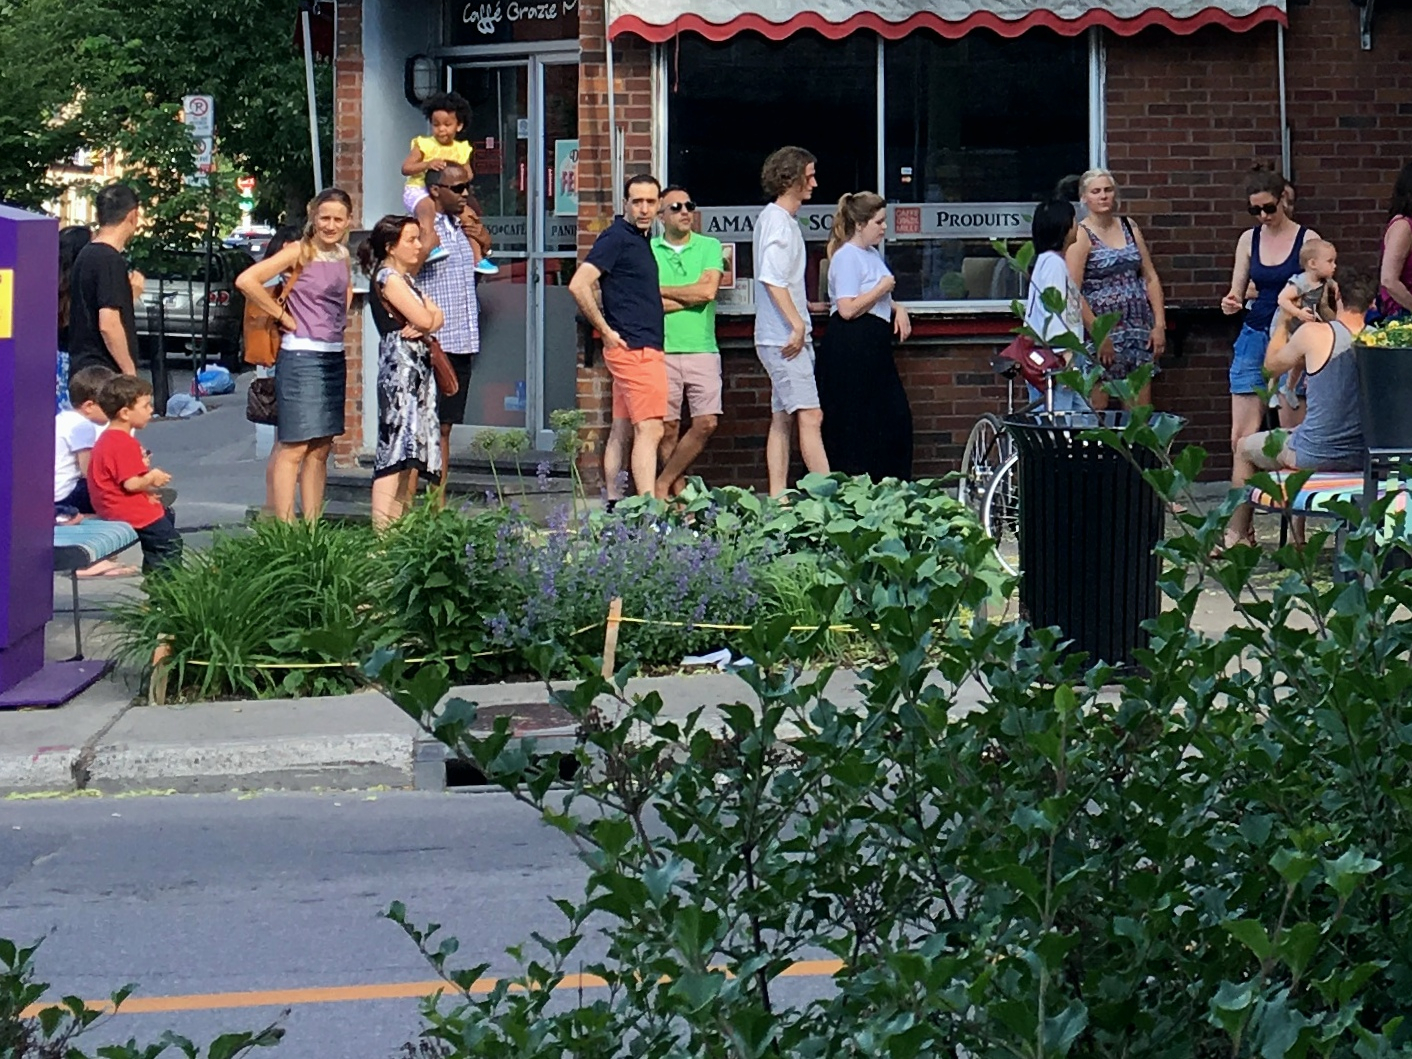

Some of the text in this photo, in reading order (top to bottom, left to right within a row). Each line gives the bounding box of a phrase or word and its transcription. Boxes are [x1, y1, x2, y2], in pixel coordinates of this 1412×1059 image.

[462, 0, 503, 34] Caffé
[506, 1, 557, 22] Grazie
[707, 214, 756, 233] AMA
